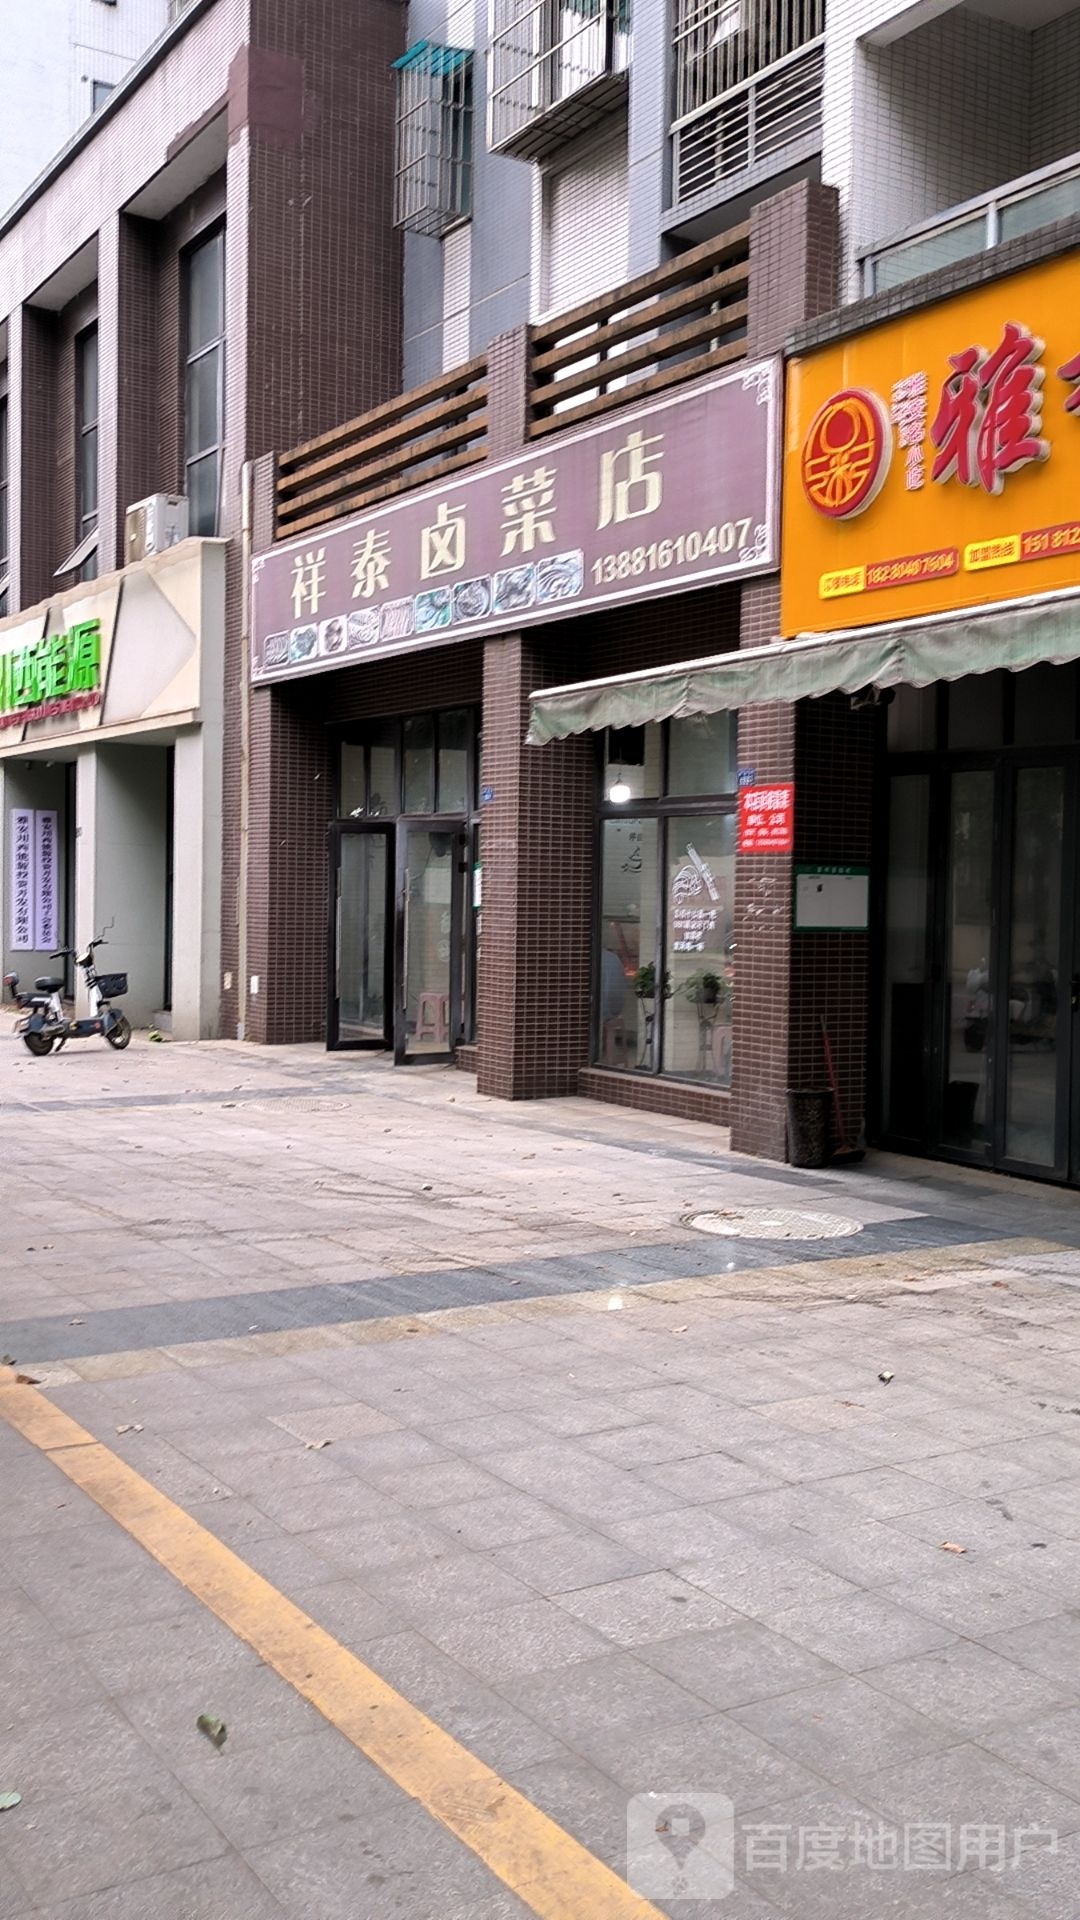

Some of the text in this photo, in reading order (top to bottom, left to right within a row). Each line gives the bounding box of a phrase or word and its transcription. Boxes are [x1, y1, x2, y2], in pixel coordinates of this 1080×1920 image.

[930, 320, 1080, 496] 雅
[289, 430, 666, 619] 祥泰卤菜店
[591, 516, 753, 585] 13881610407
